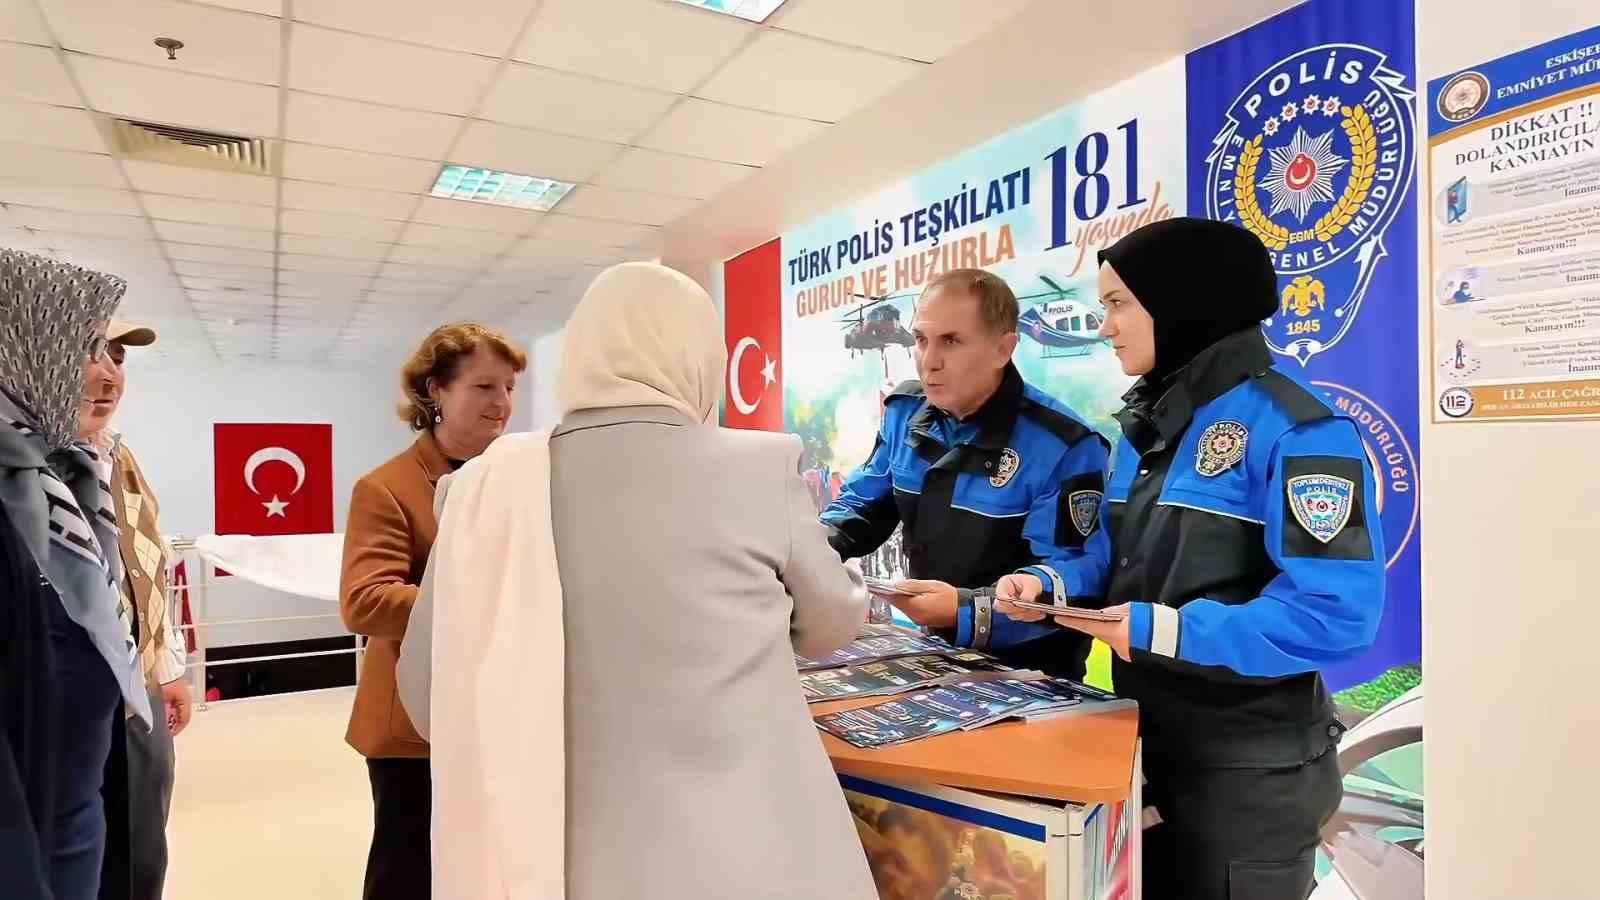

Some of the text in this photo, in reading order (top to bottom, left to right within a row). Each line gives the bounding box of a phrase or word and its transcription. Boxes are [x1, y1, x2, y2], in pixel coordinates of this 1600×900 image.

[1244, 50, 1364, 118] POLİS
[1497, 68, 1567, 99] EMNİYET
[1490, 106, 1574, 141] DİKKAT
[1219, 134, 1244, 222] EMNİY
[1348, 88, 1398, 237] MÜDÜRLÜĞÜ
[1490, 138, 1594, 173] KANMAYIN
[1044, 117, 1148, 252] 181
[788, 166, 1031, 286] TÜRK POLİS TEŞKİLATI
[1288, 229, 1315, 244] EGM
[796, 223, 1017, 318] GURUR VE HUZURLA
[1286, 319, 1320, 335] 1845
[1446, 395, 1466, 408] 112
[1503, 388, 1525, 401] 112
[1336, 396, 1409, 493] MÜDÜRLÜĞÜ
